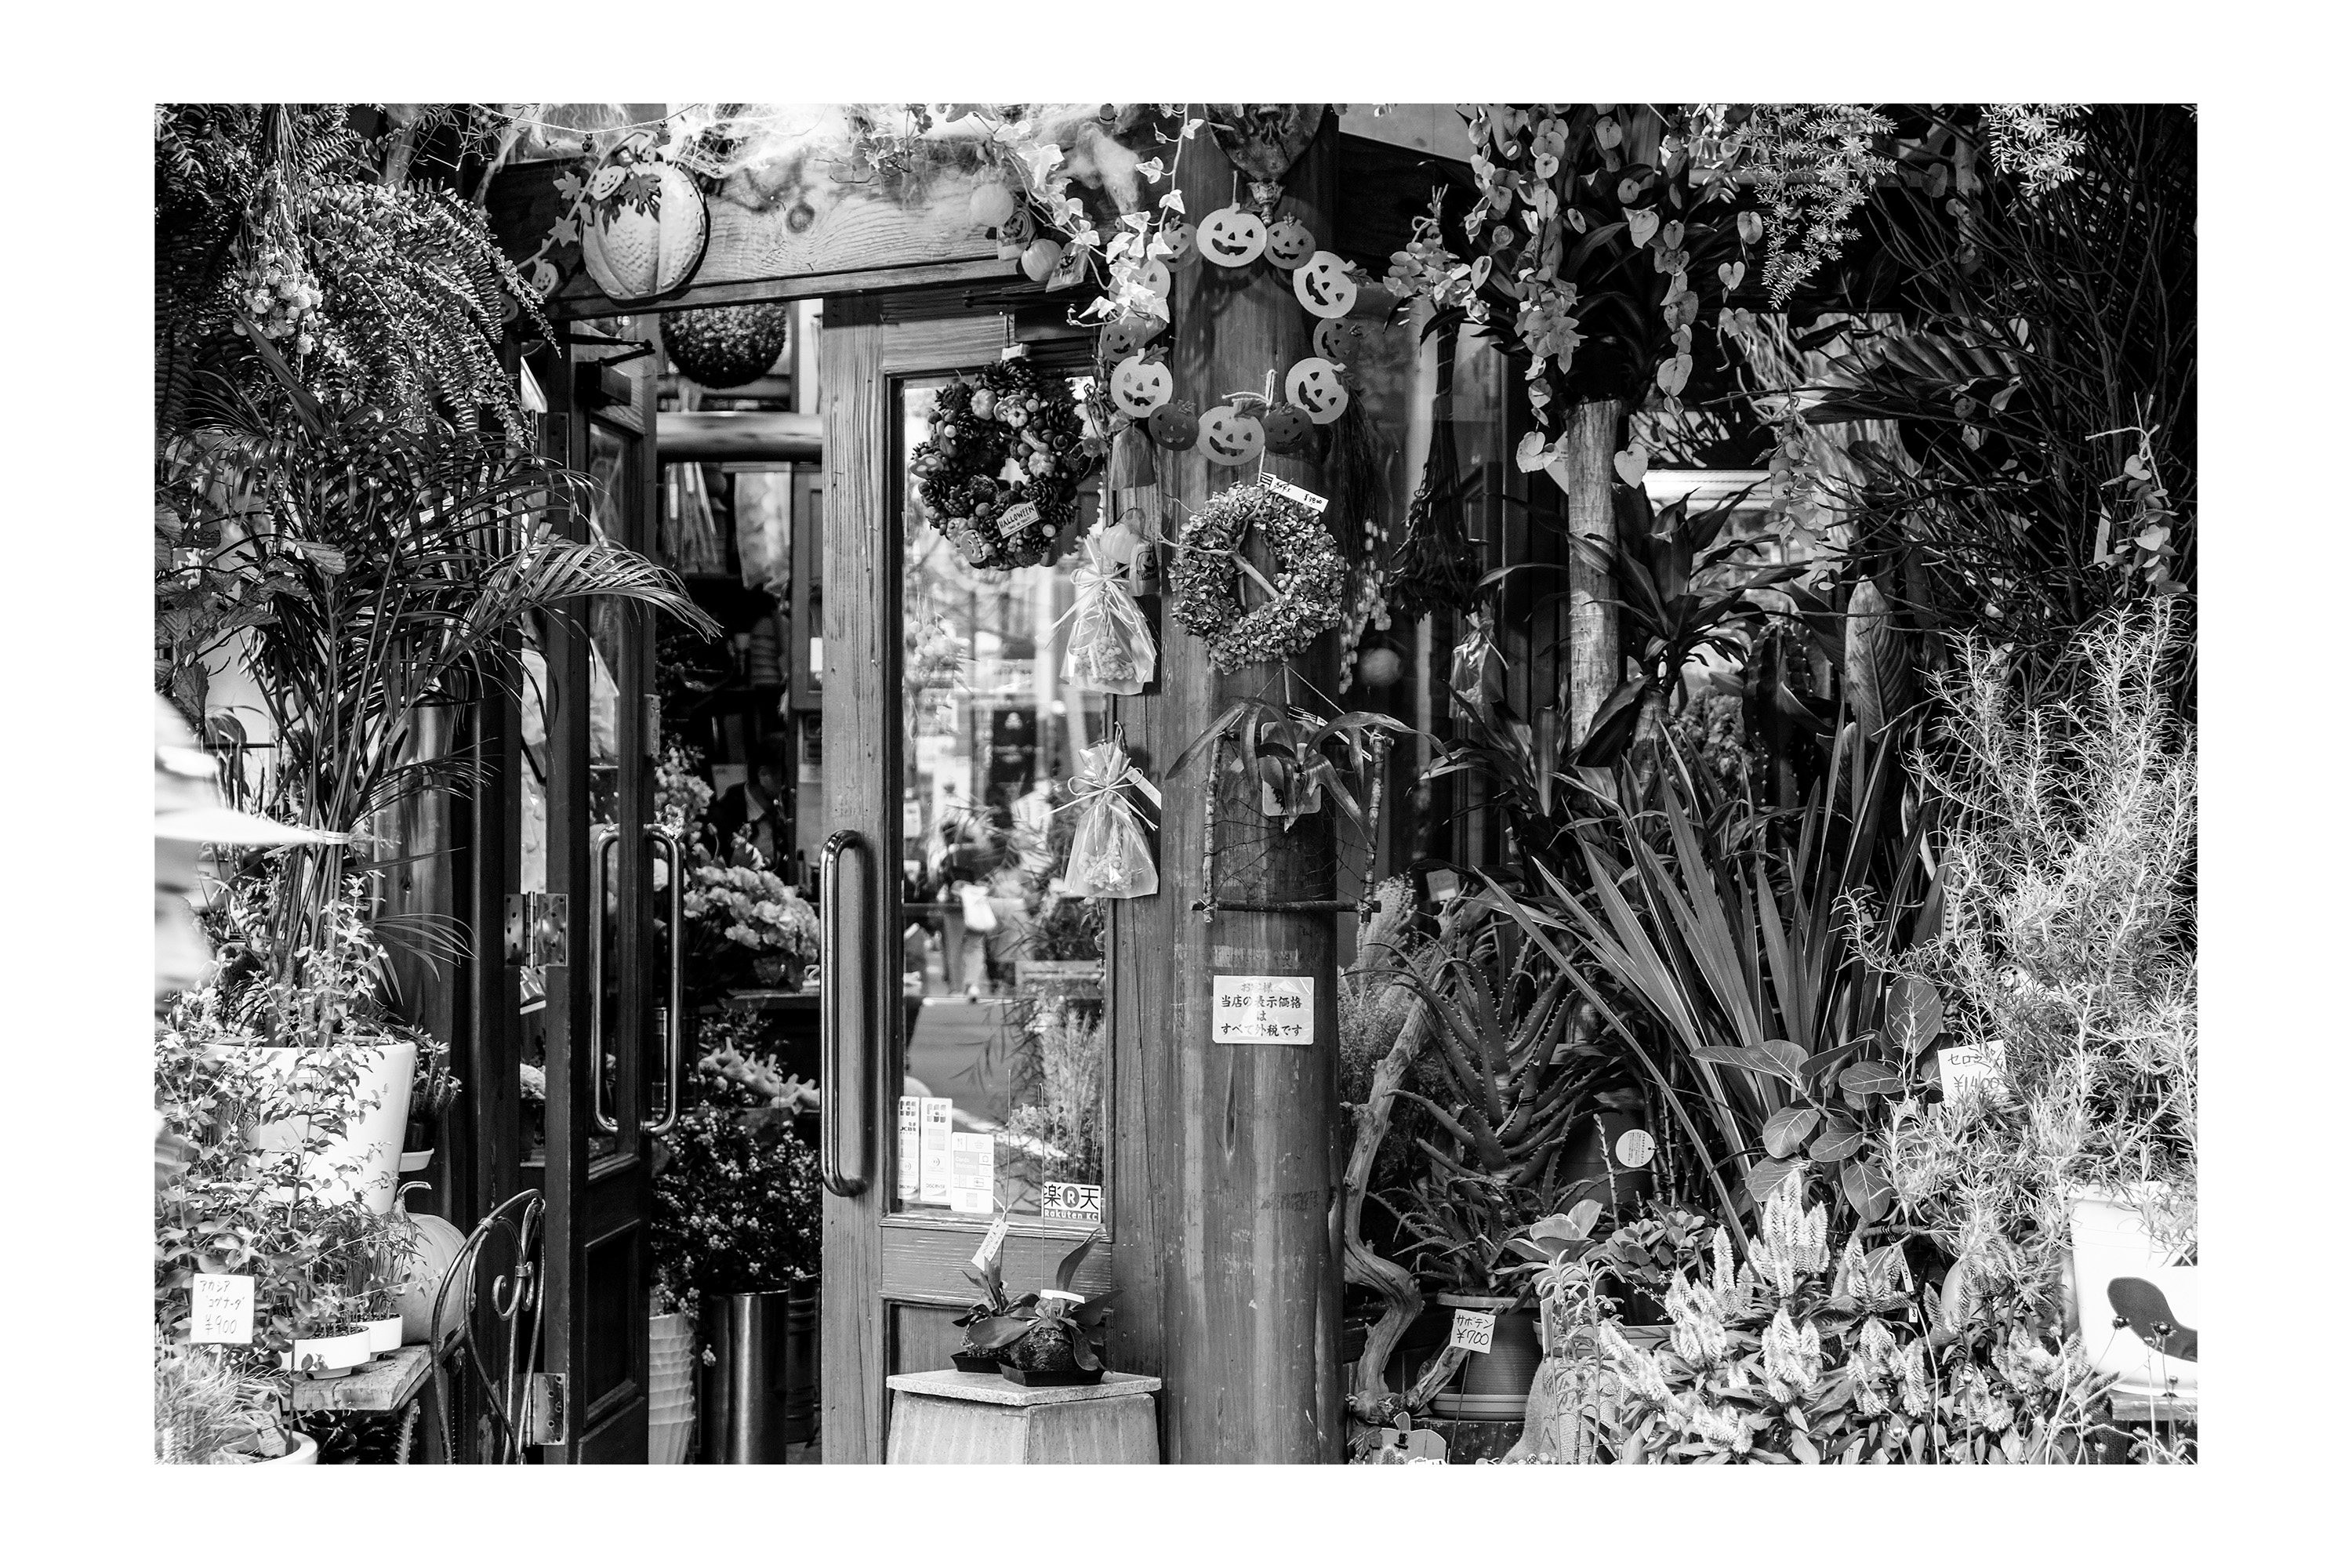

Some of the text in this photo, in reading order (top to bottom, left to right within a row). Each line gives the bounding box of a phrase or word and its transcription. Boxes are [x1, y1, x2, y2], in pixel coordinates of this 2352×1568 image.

[998, 505, 1035, 529] HALLOWEEN
[1221, 994, 1302, 1009] 当店の表示価格
[1257, 1010, 1267, 1022] は
[1221, 1022, 1302, 1036] すべて外税です
[1044, 1209, 1098, 1221] Rakuten KC
[200, 1279, 230, 1293] アカシア
[205, 1313, 238, 1335] ¥900
[1456, 1314, 1494, 1330] サボテン
[1456, 1328, 1490, 1345] ¥700
